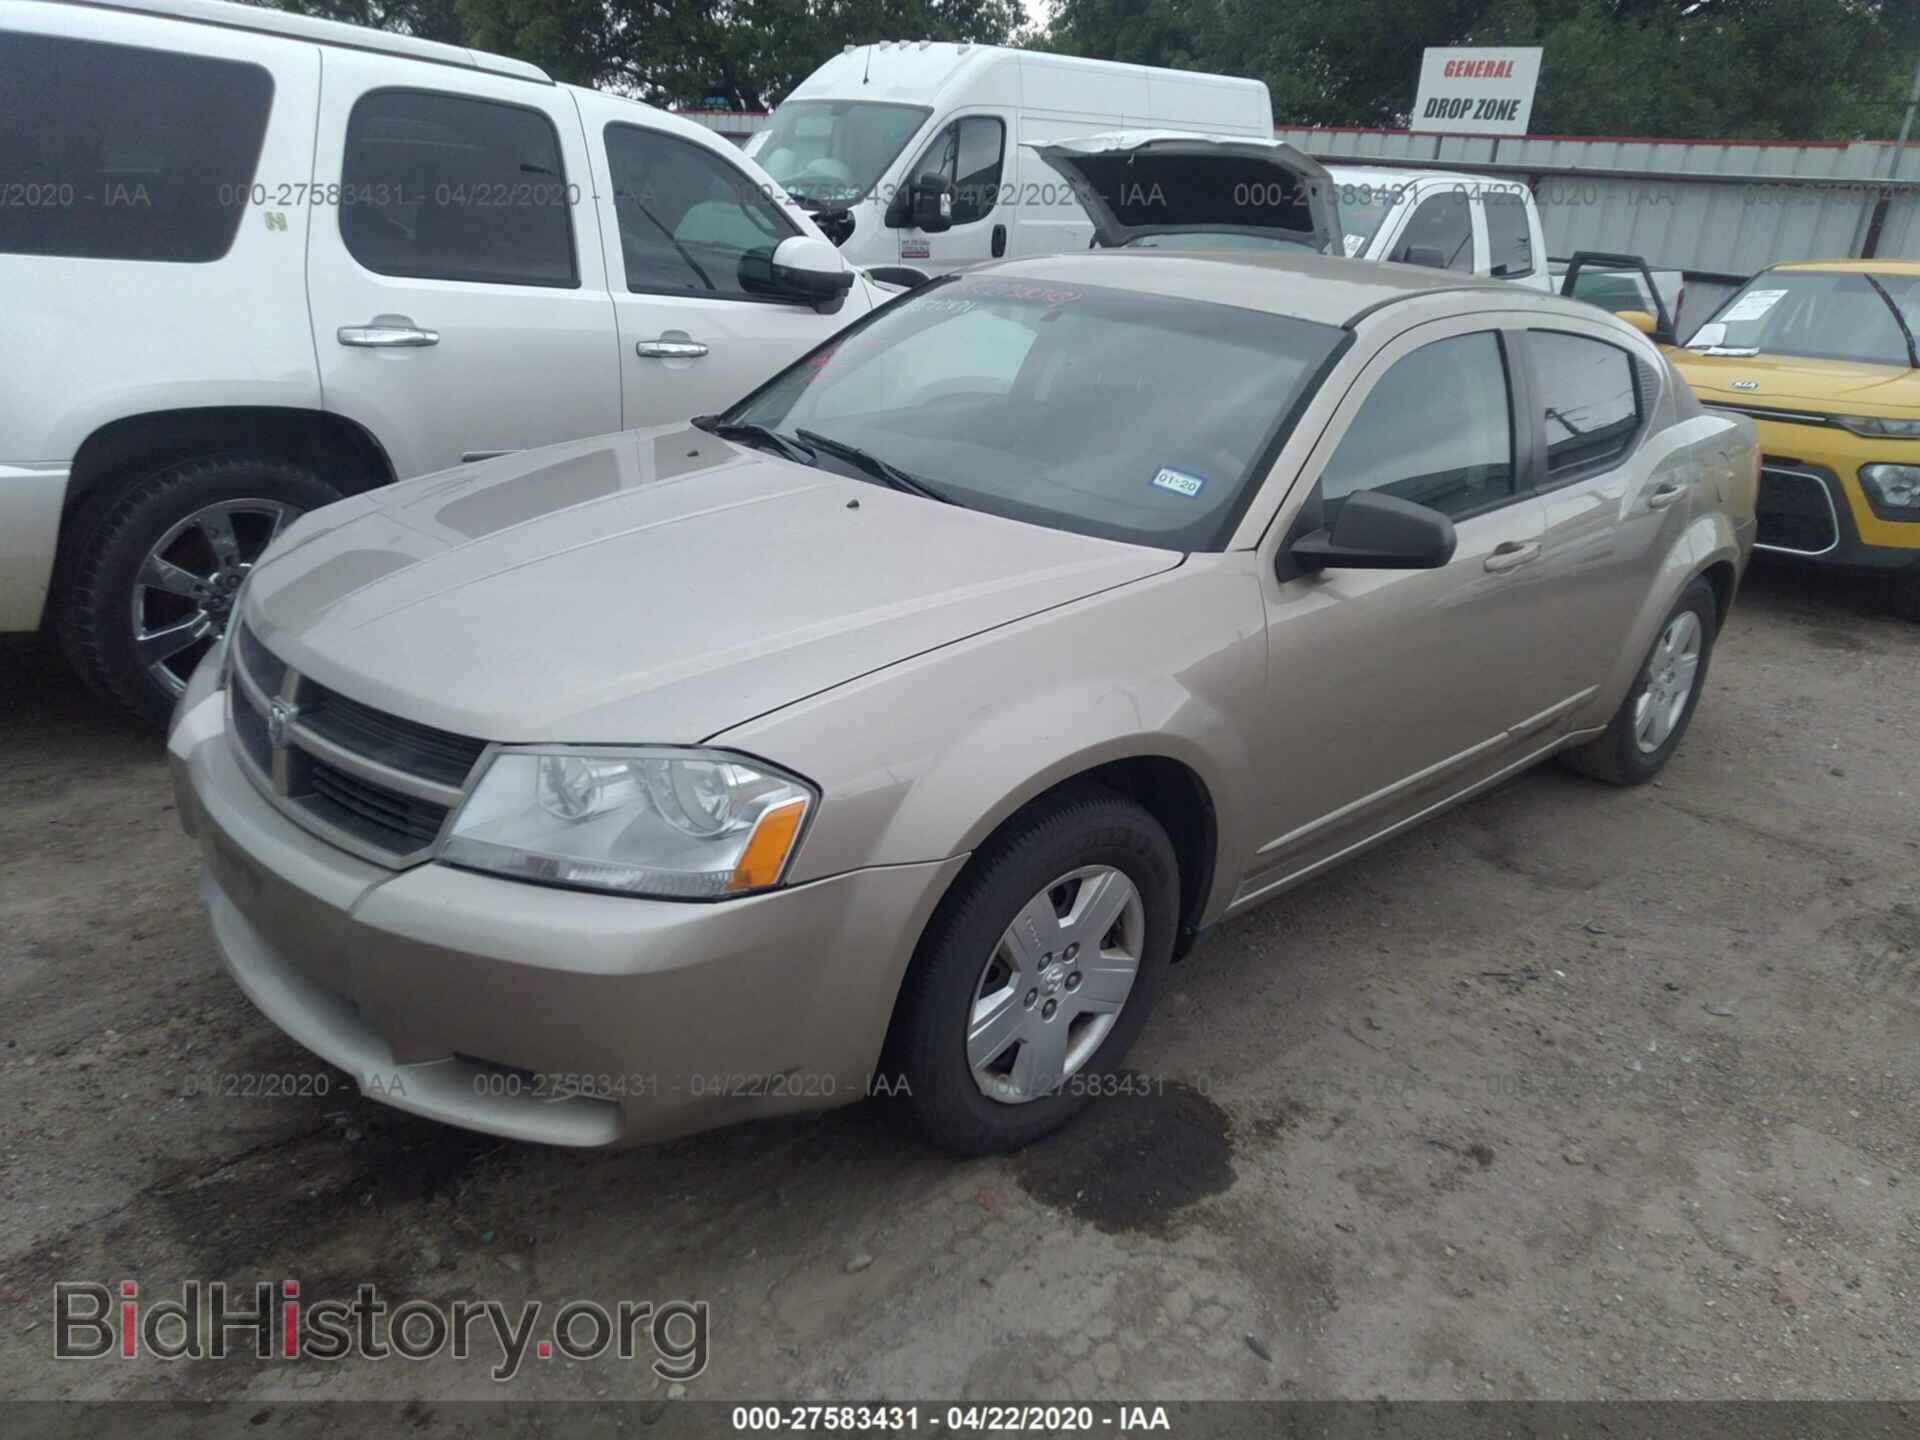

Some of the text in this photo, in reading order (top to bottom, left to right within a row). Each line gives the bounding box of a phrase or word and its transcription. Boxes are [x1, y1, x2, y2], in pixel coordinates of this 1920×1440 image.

[1444, 60, 1514, 78] GENERAL
[1423, 97, 1522, 120] DROP ZONE
[1158, 472, 1198, 492] 01-20
